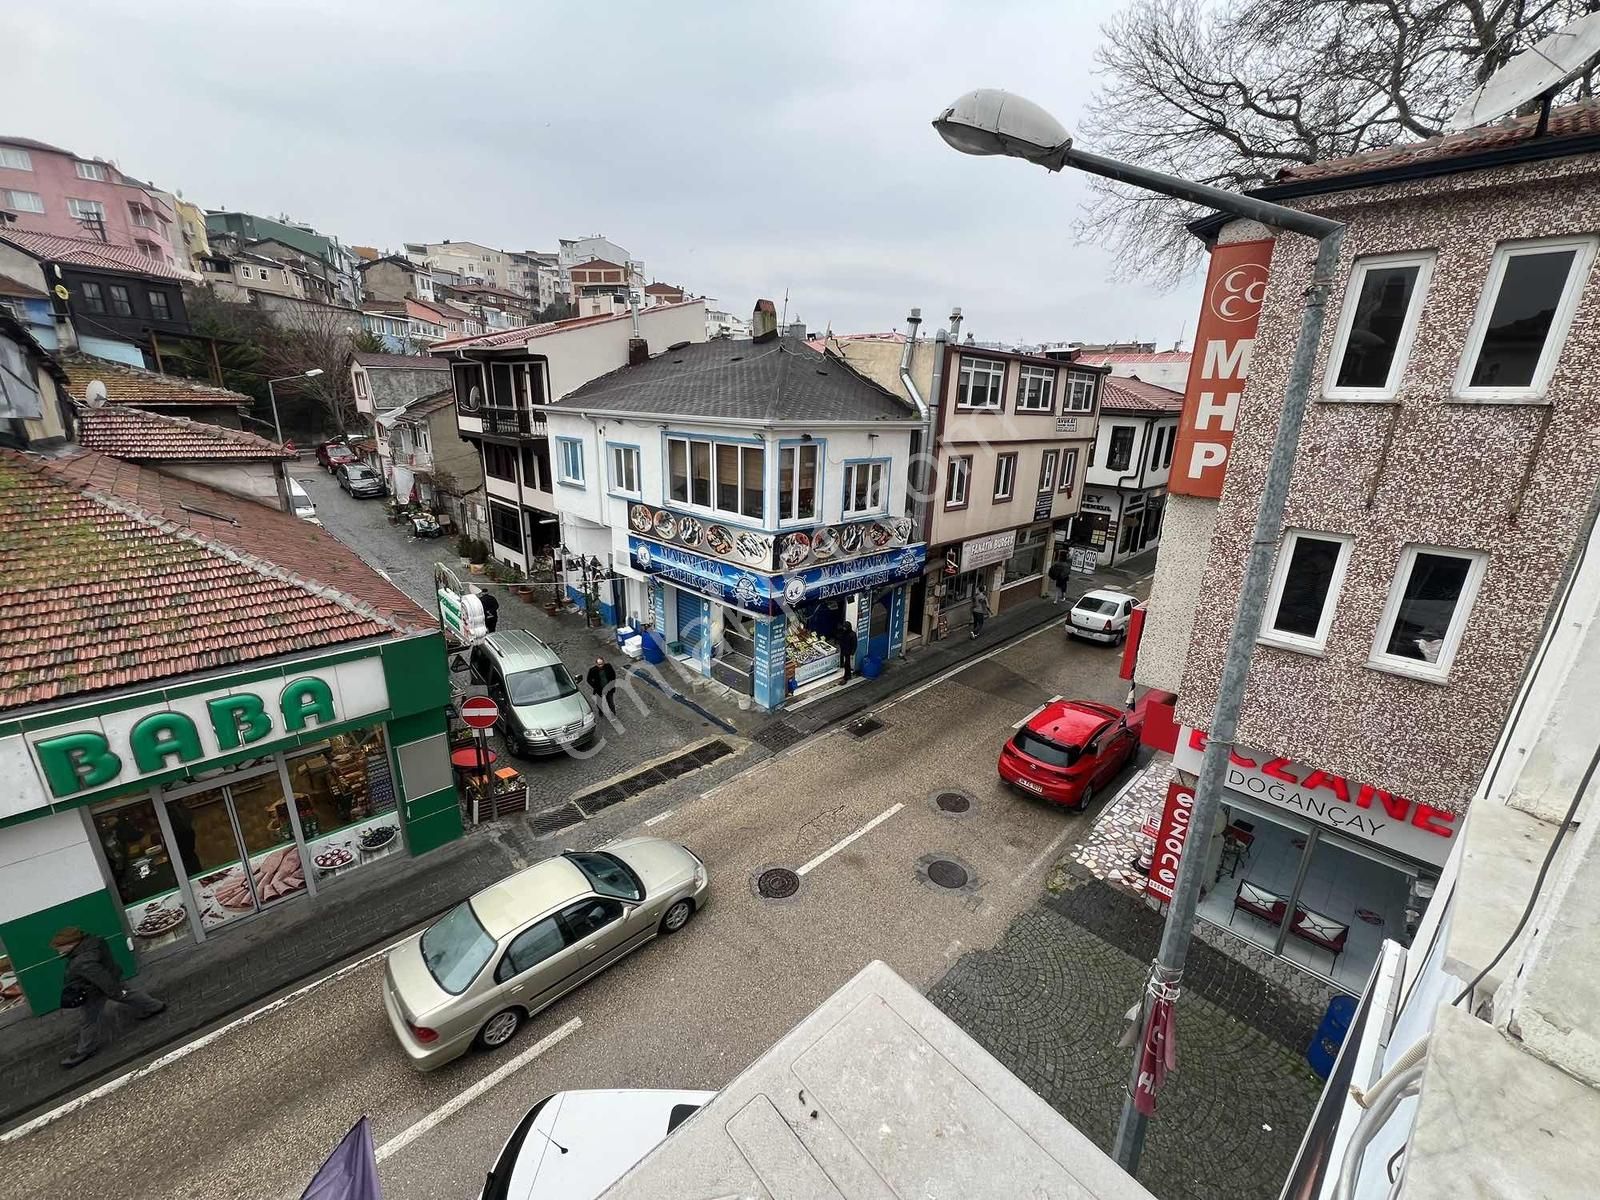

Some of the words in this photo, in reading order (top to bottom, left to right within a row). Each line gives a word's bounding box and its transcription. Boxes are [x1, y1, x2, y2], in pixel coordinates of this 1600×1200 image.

[1187, 339, 1255, 479] MHP
[660, 547, 724, 577] MARMARA
[819, 570, 890, 600] BALIKÇISI
[821, 553, 891, 579] MARMARA
[34, 676, 336, 798] BABA
[1229, 769, 1385, 836] DOĞANÇAY
